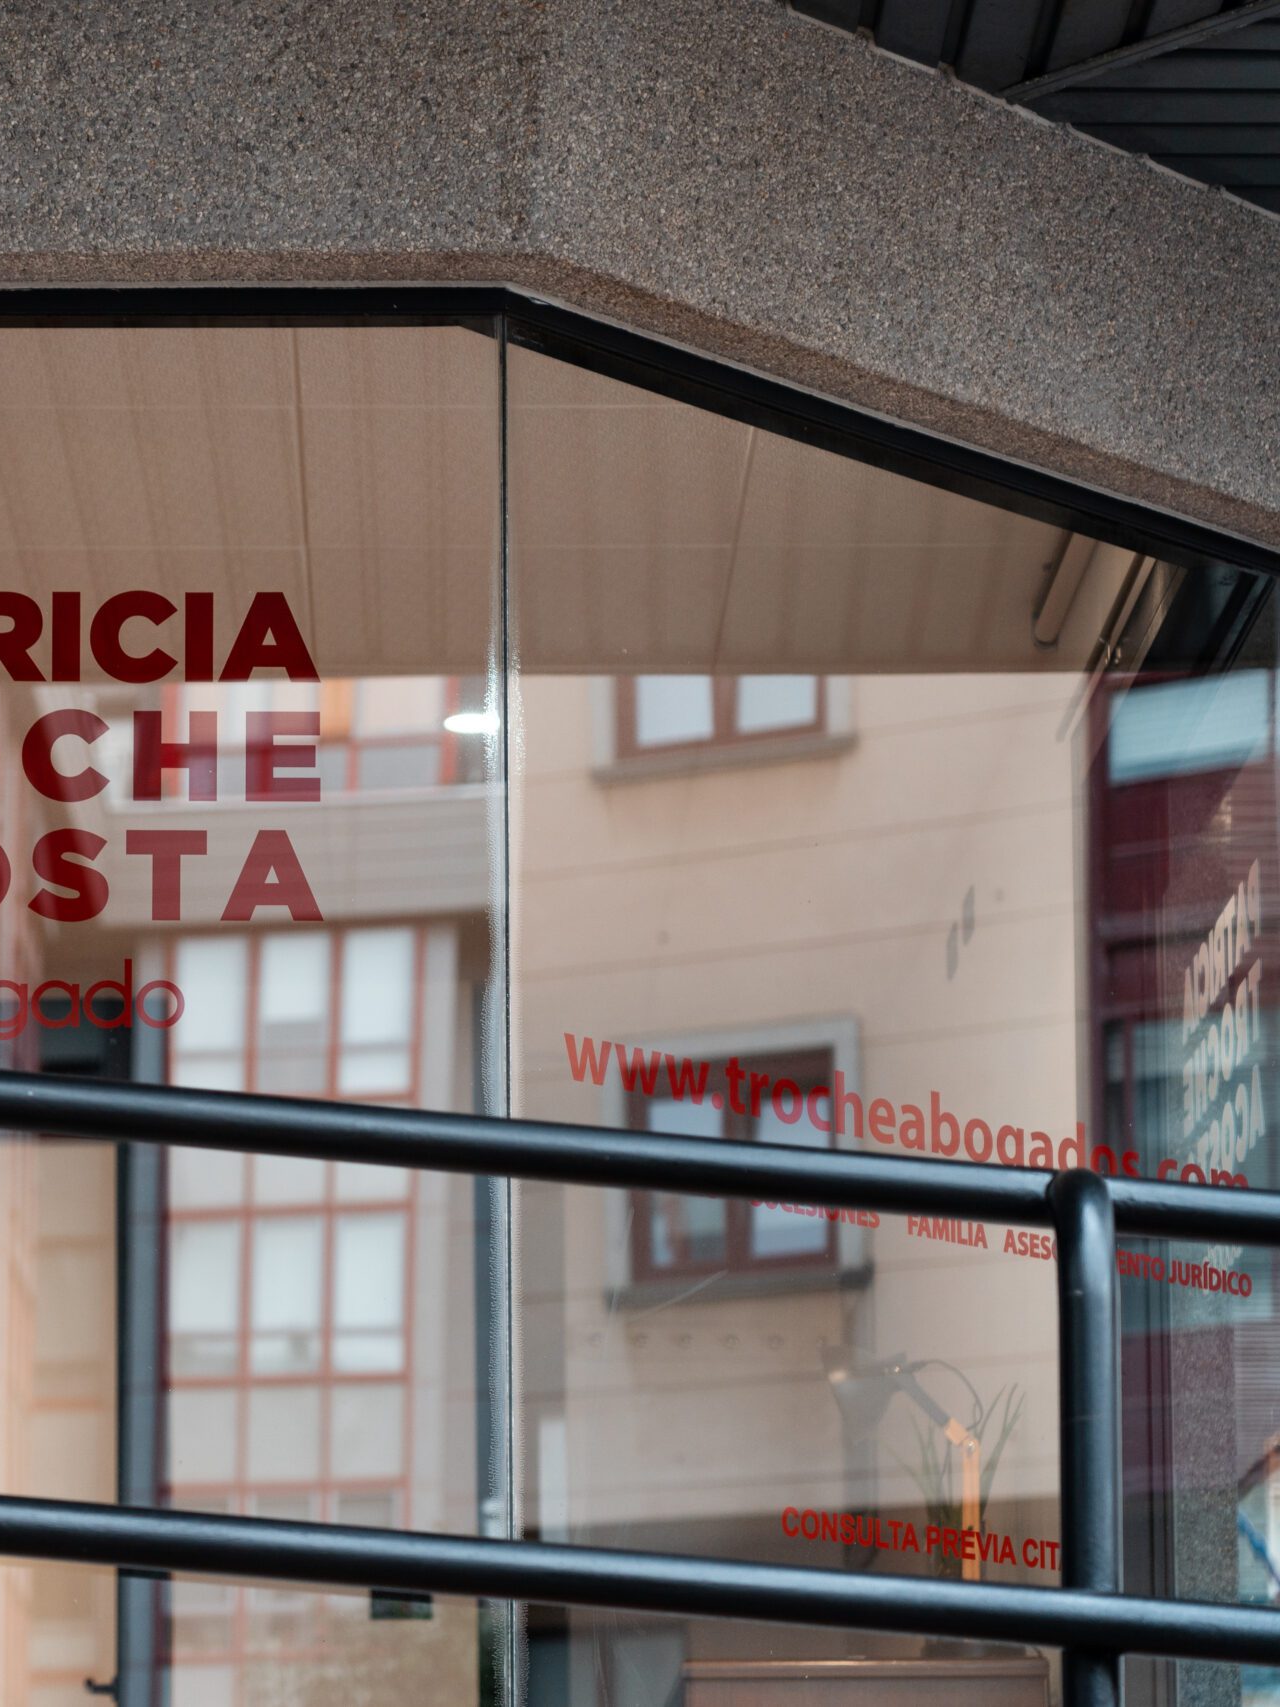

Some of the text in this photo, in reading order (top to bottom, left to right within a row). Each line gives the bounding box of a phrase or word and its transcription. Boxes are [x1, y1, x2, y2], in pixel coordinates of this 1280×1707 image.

[564, 1032, 1249, 1188] www.trocheabogados
[907, 1215, 988, 1249] FAMILIA
[1168, 1260, 1252, 1297] JURÍDICO
[782, 1506, 1061, 1571] CONSULTA PREVIA CIT
